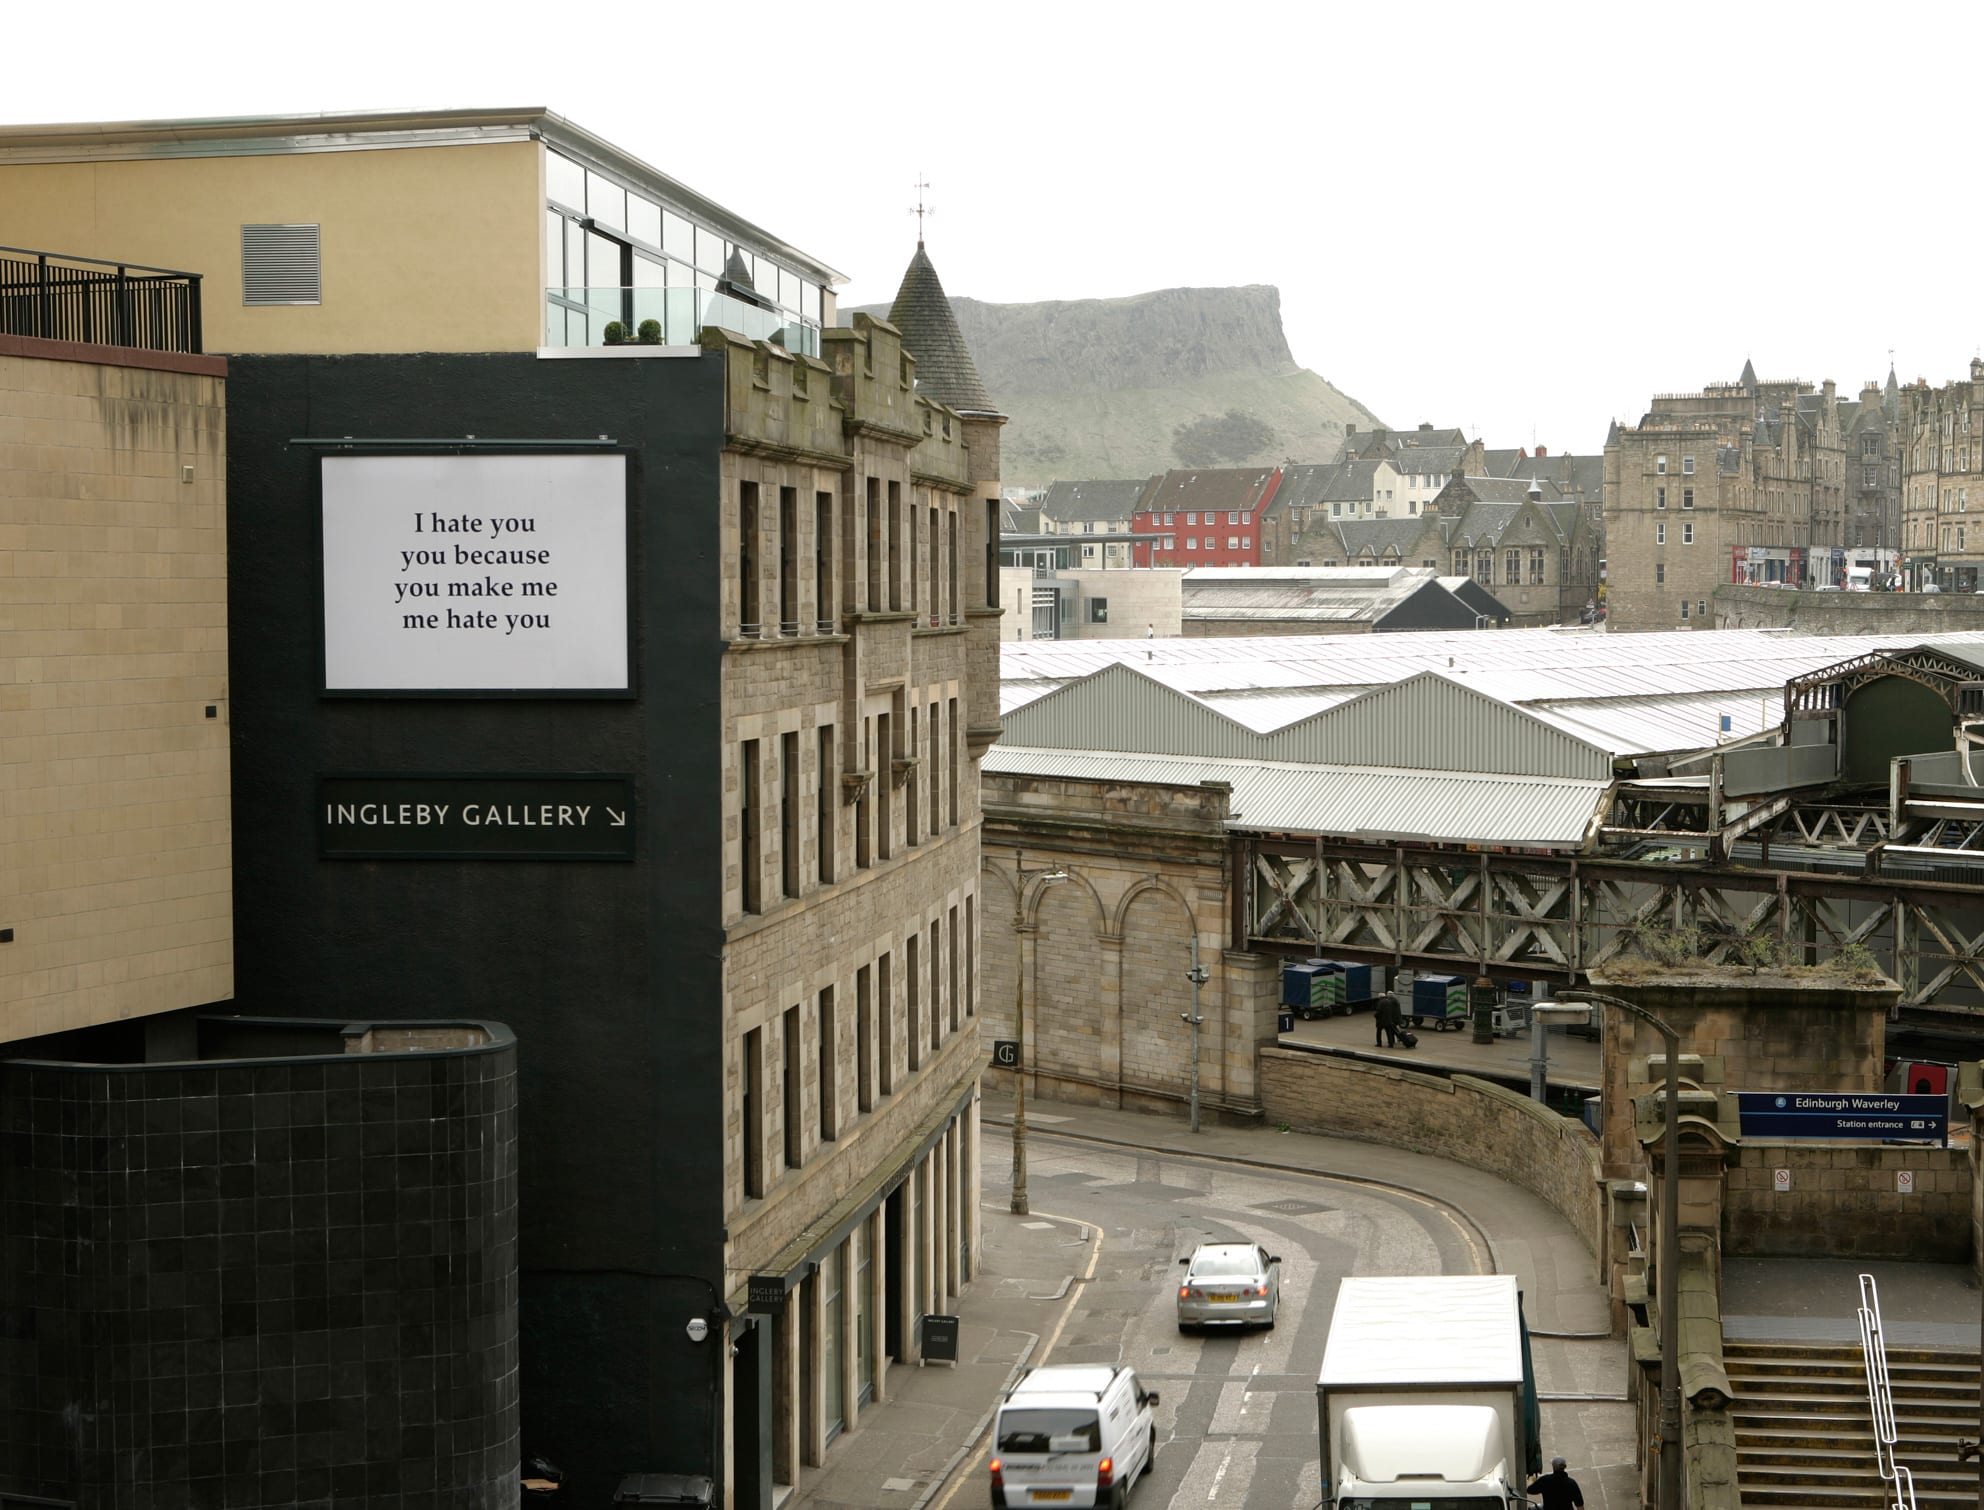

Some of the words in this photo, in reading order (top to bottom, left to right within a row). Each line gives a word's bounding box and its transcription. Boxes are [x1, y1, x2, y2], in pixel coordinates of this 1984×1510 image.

[415, 512, 424, 533] I
[431, 512, 483, 533] hate
[490, 517, 536, 540] you
[401, 550, 446, 571] you
[454, 544, 550, 565] because
[395, 582, 440, 604] you
[447, 576, 514, 597] make
[521, 582, 558, 597] me
[402, 614, 439, 629] me
[446, 608, 498, 629] hate
[504, 614, 550, 635] you
[327, 803, 449, 825] INGLEBY
[462, 804, 591, 826] GALLERY
[1283, 1017, 1289, 1030] 1
[1795, 1097, 1849, 1111] Edinburgh
[1852, 1098, 1900, 1111] Waverley
[1836, 1119, 1867, 1129] Station
[1868, 1120, 1904, 1129] entrance
[749, 1295, 783, 1303] GALLERY
[750, 1288, 783, 1296] INGLEBY
